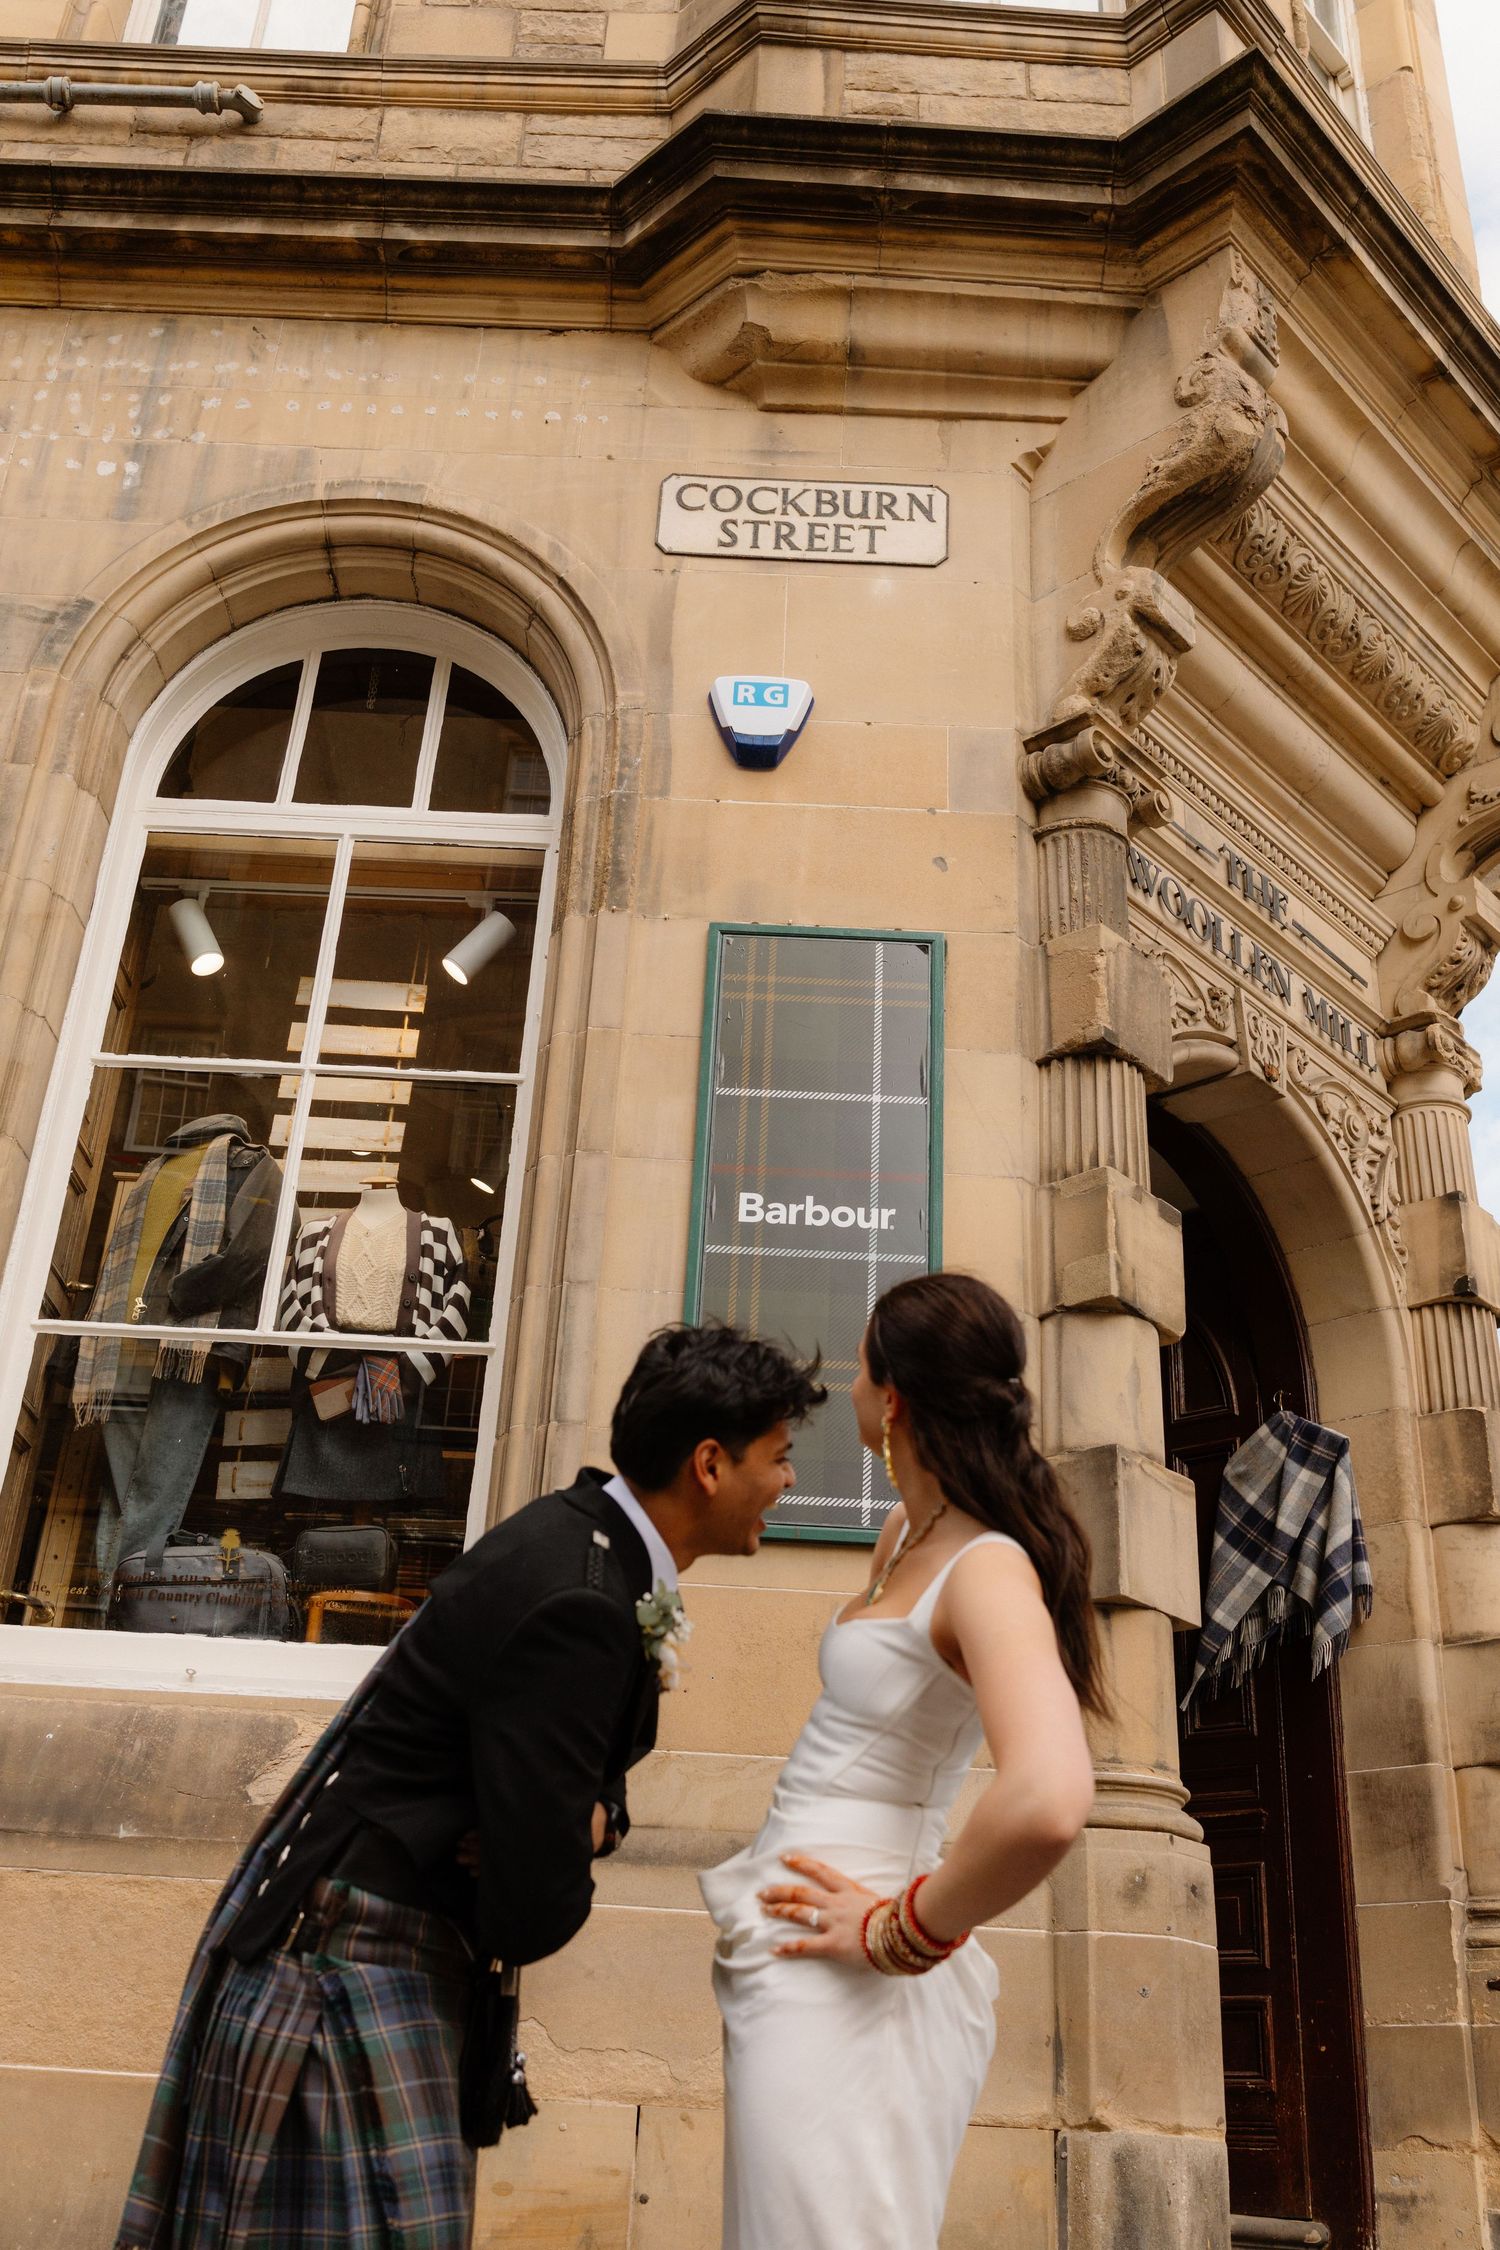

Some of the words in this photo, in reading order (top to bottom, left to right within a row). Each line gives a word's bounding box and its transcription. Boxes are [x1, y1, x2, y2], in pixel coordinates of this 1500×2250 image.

[675, 483, 937, 523] COCKBURN
[717, 518, 887, 554] STREET
[1219, 843, 1289, 932] THE
[1129, 847, 1293, 1007] WOOLLEN
[1303, 983, 1377, 1073] MILL
[738, 1191, 897, 1231] Barbour
